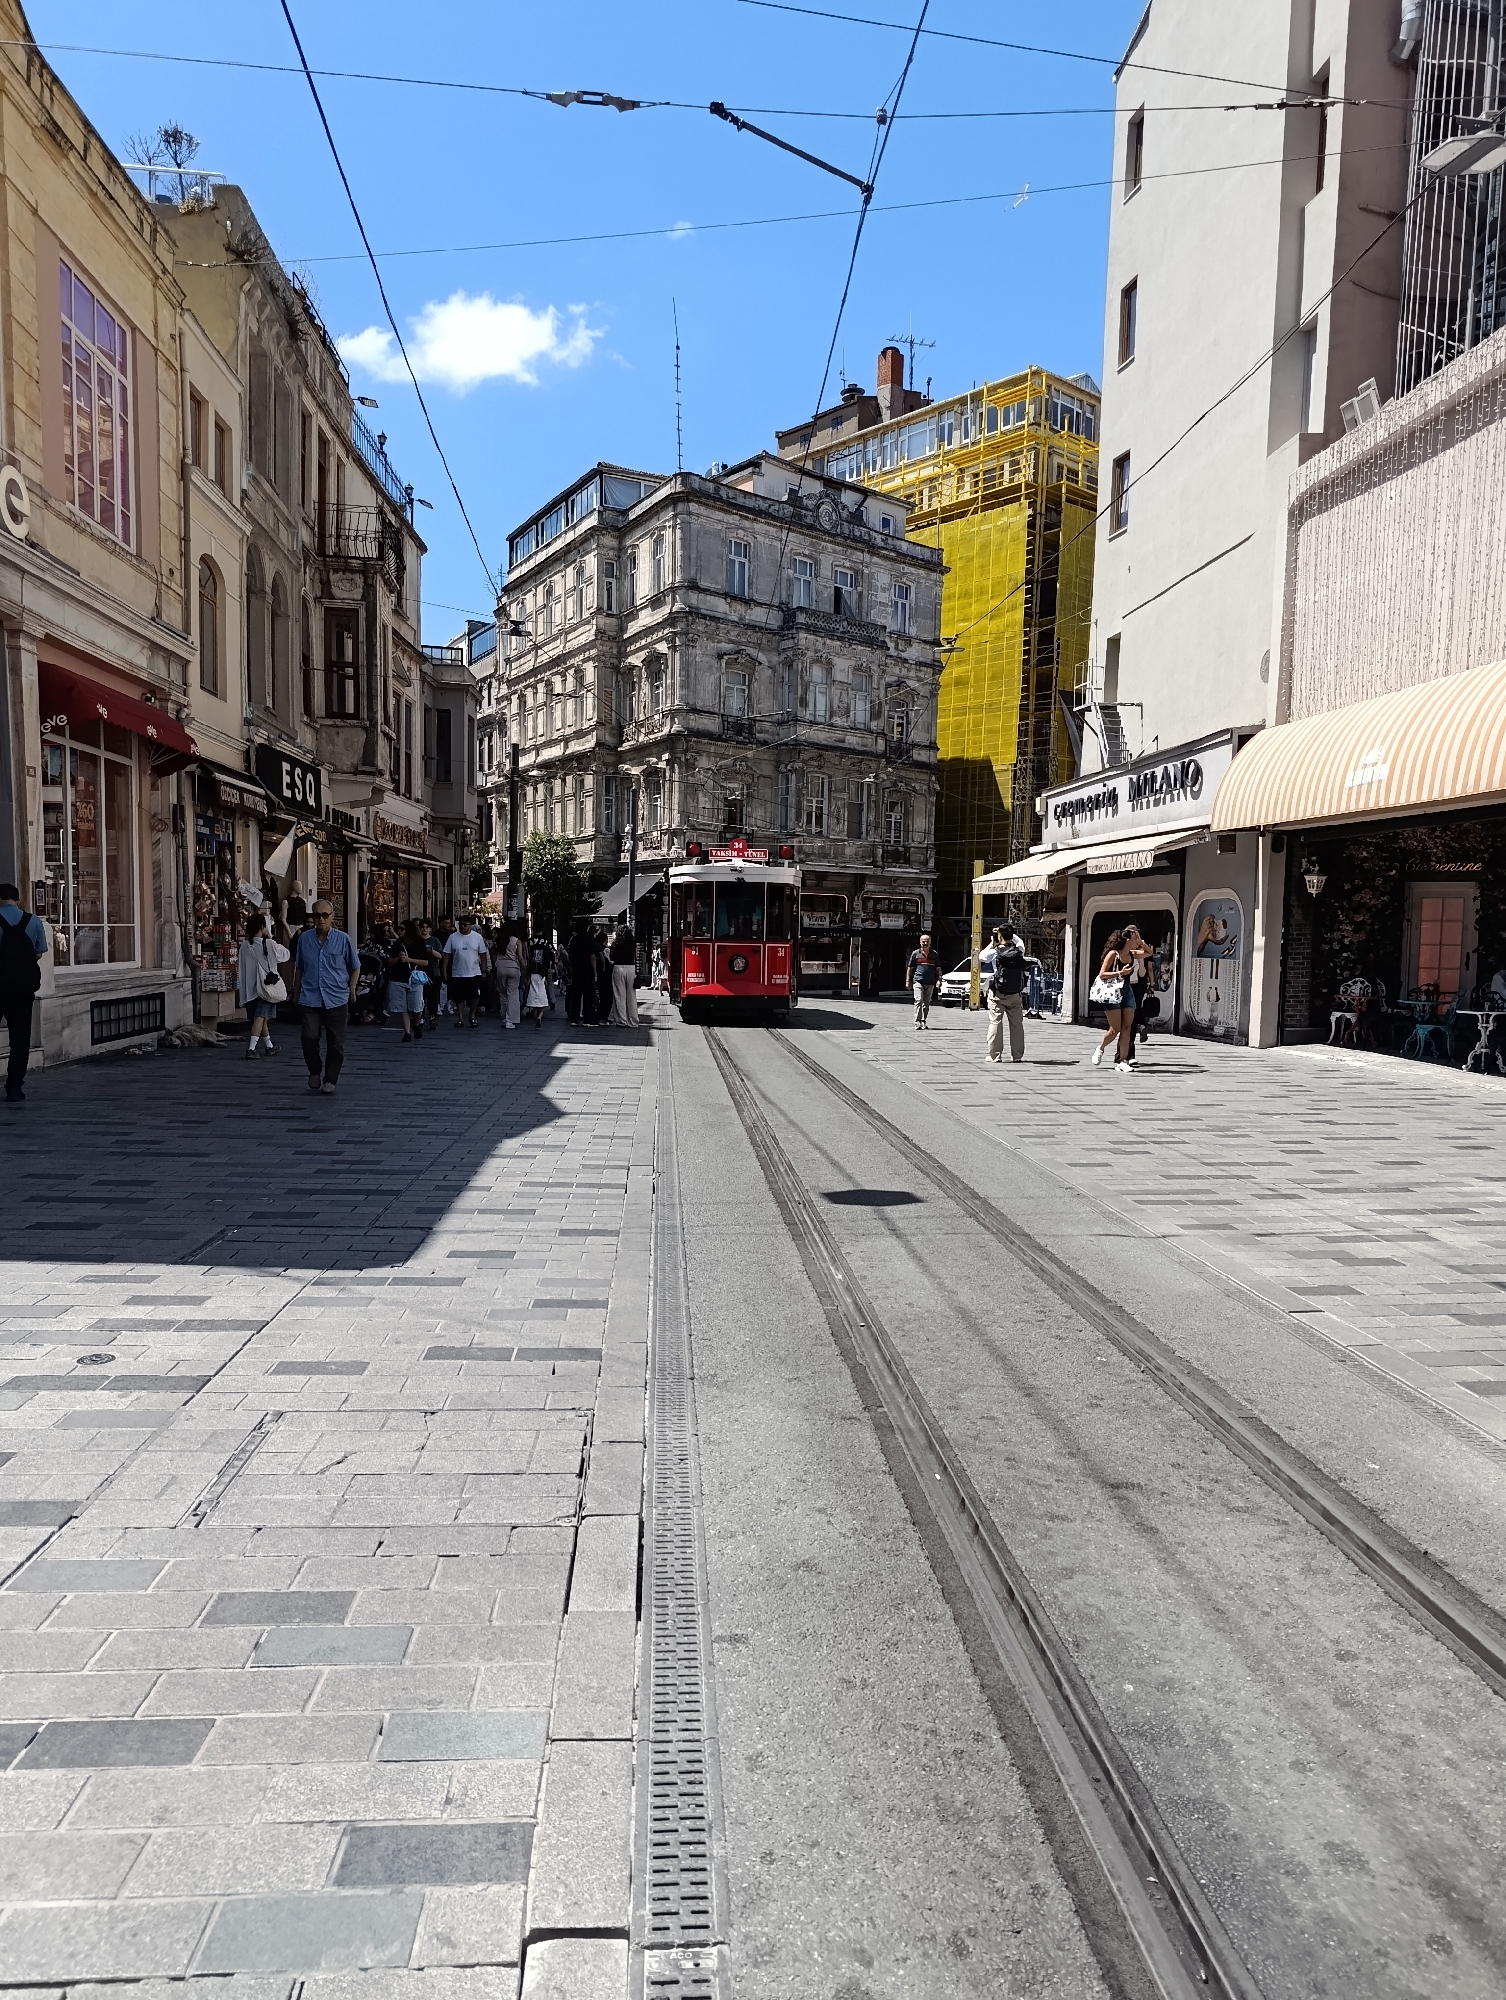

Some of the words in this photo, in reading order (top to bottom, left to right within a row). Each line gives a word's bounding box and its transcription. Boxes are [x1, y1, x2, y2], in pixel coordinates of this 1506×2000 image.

[41, 714, 67, 733] eve
[147, 724, 158, 739] eve
[282, 761, 316, 810] ESQ
[1053, 782, 1117, 821] cremeria
[1127, 758, 1201, 803] MILANO
[744, 849, 766, 858] TÜNEL
[1110, 851, 1154, 871] MILANO
[777, 947, 785, 957] 34
[669, 1952, 693, 1960] ACO
